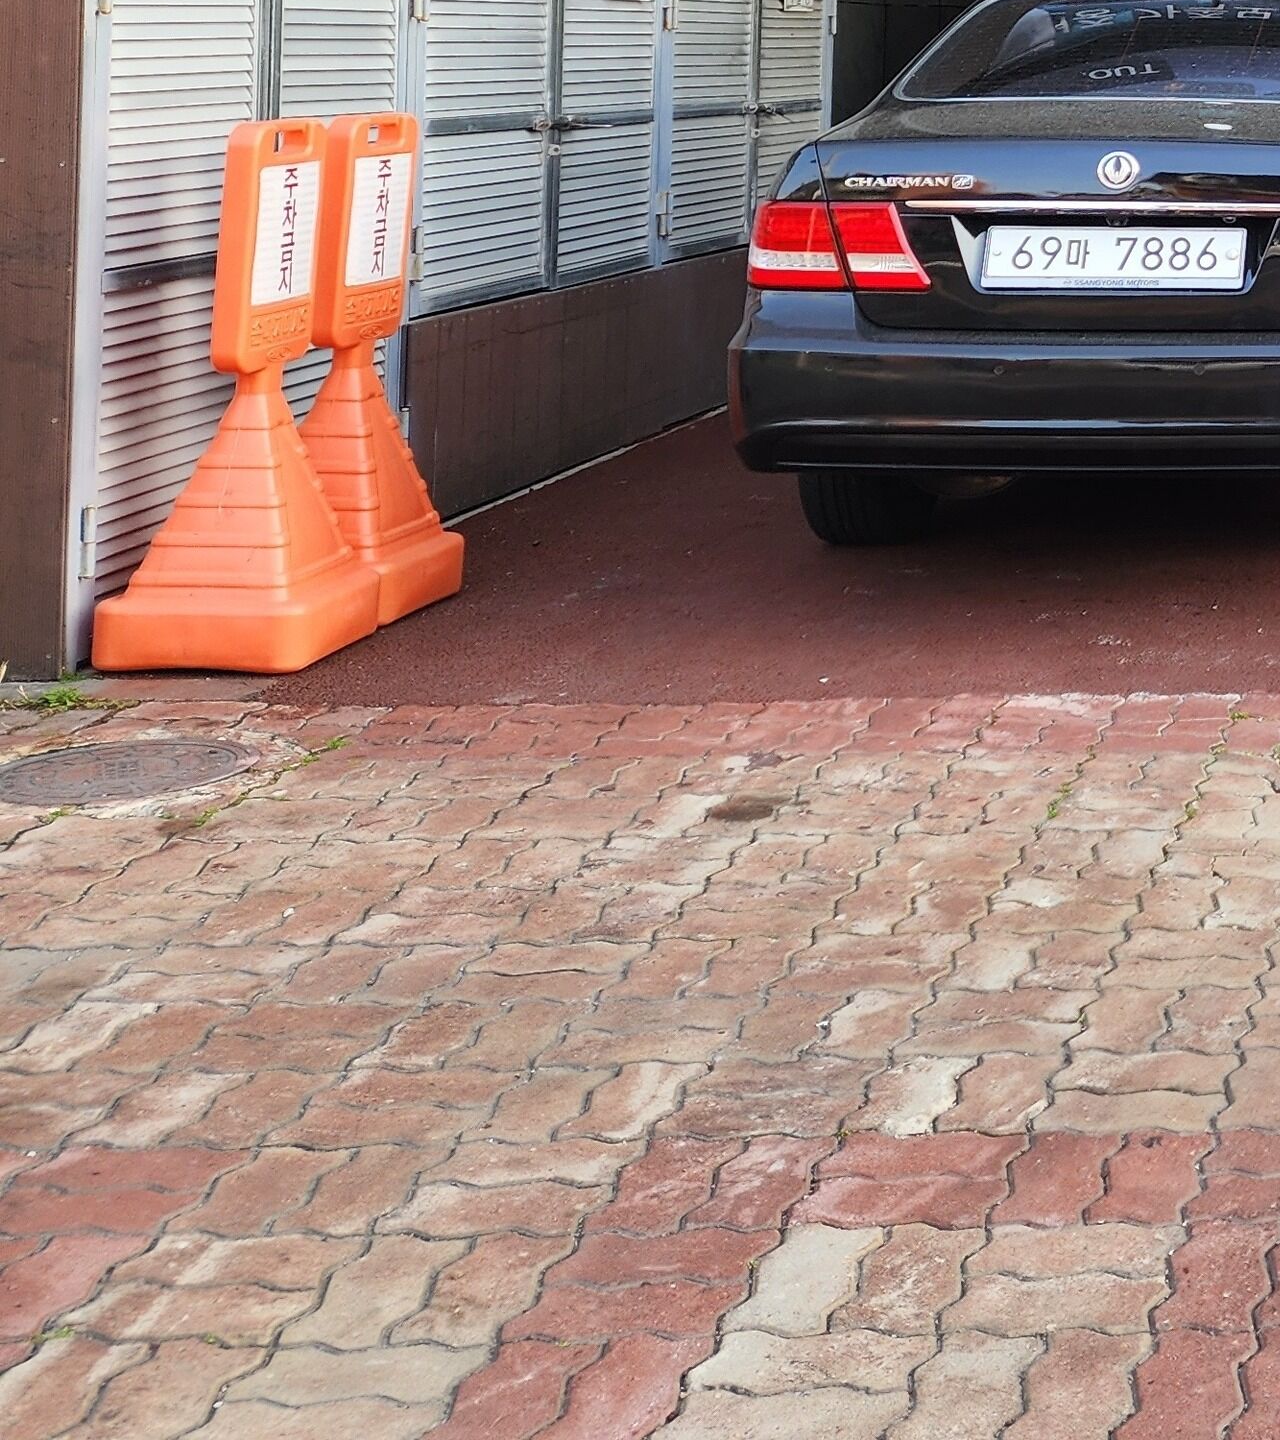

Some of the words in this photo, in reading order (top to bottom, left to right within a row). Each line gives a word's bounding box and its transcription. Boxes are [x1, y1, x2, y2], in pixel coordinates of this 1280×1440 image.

[844, 175, 950, 189] CHAIRMAN
[278, 167, 299, 294] 주차금지
[371, 158, 392, 276] 주차금지
[1011, 235, 1090, 271] 69마
[1115, 236, 1218, 272] 7886
[1074, 279, 1123, 287] SSANGYONG
